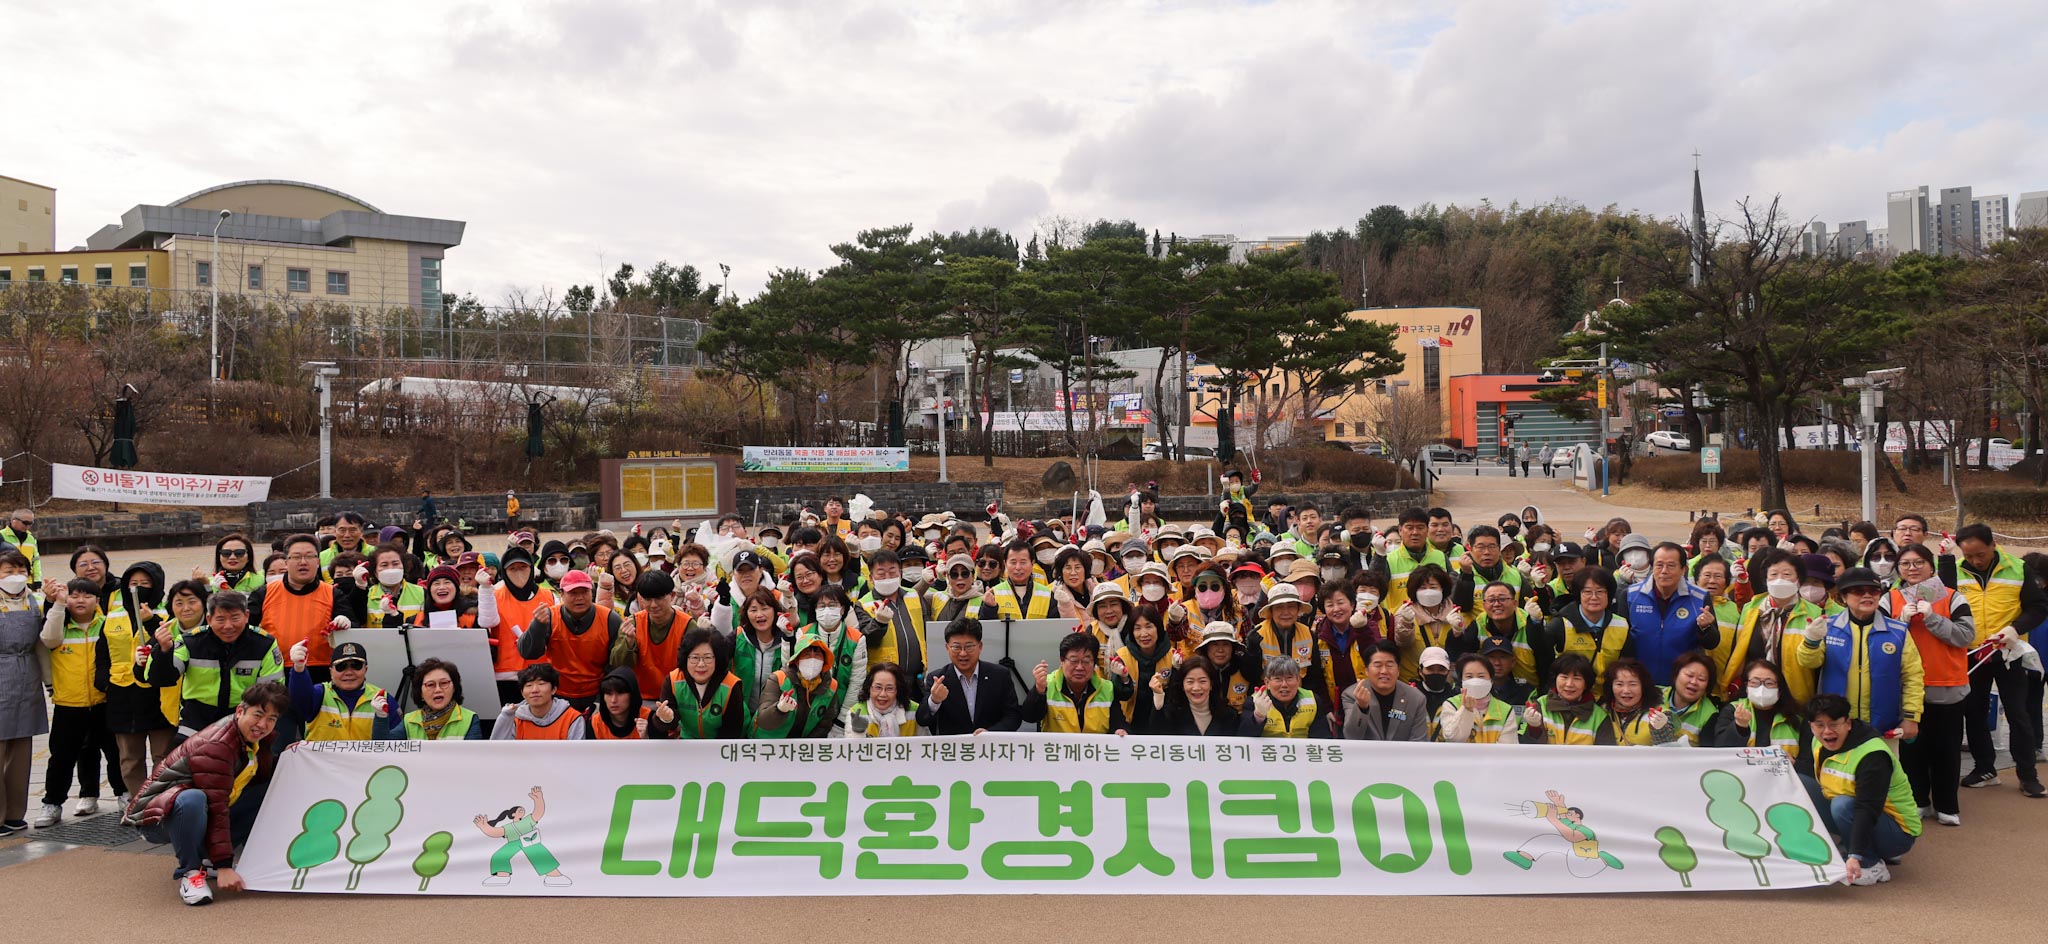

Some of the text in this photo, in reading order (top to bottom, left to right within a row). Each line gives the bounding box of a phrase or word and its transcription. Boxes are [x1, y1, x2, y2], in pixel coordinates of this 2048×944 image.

[1446, 314, 1474, 336] 119
[103, 472, 149, 488] 비둘기
[155, 476, 213, 491] 먹이주기
[217, 479, 244, 493] 금지
[311, 740, 422, 753] 대덕구자원봉사센터
[720, 742, 1344, 762] 대덕구자원봉사센터와 자원봉사자가 함께하는 우리동네 정기 줍깅 활동
[600, 775, 1473, 881] 대덕환경지킴이
